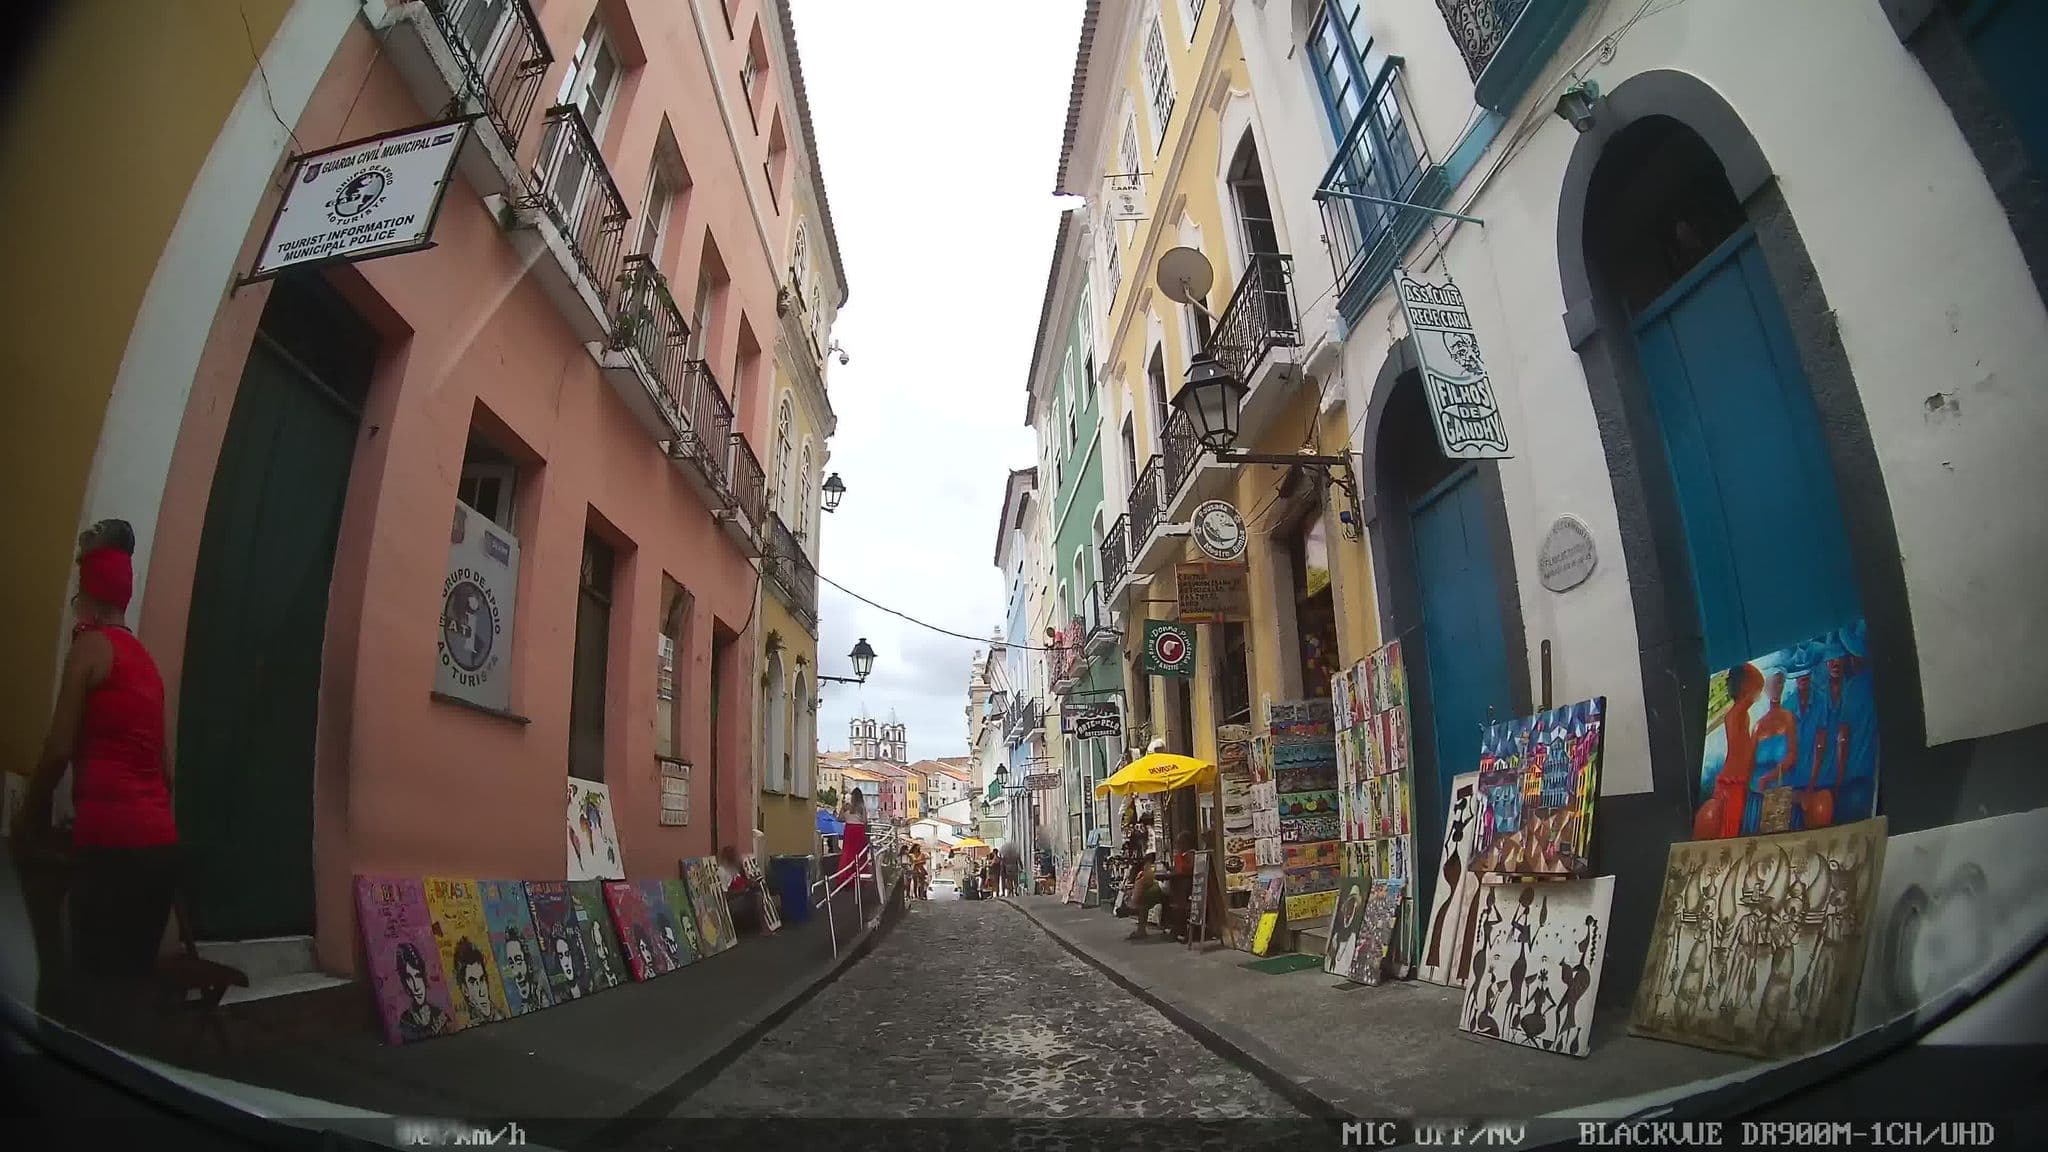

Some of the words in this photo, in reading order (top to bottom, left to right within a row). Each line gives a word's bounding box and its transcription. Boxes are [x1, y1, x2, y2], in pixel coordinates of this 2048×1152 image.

[322, 154, 355, 174] GUARDA
[356, 148, 380, 165] CIVIL
[380, 137, 431, 159] MUNICIPAL
[277, 233, 327, 254] TOURIST
[327, 214, 415, 241] INFORMATION
[283, 242, 346, 262] MUNICIPAL
[349, 228, 397, 247] POLICE
[1435, 378, 1491, 408] FILHOS
[1441, 410, 1506, 445] GANDHY
[1459, 406, 1480, 419] DE
[442, 567, 471, 598] GRUPO
[473, 571, 486, 588] DE
[485, 588, 501, 635] APOIO
